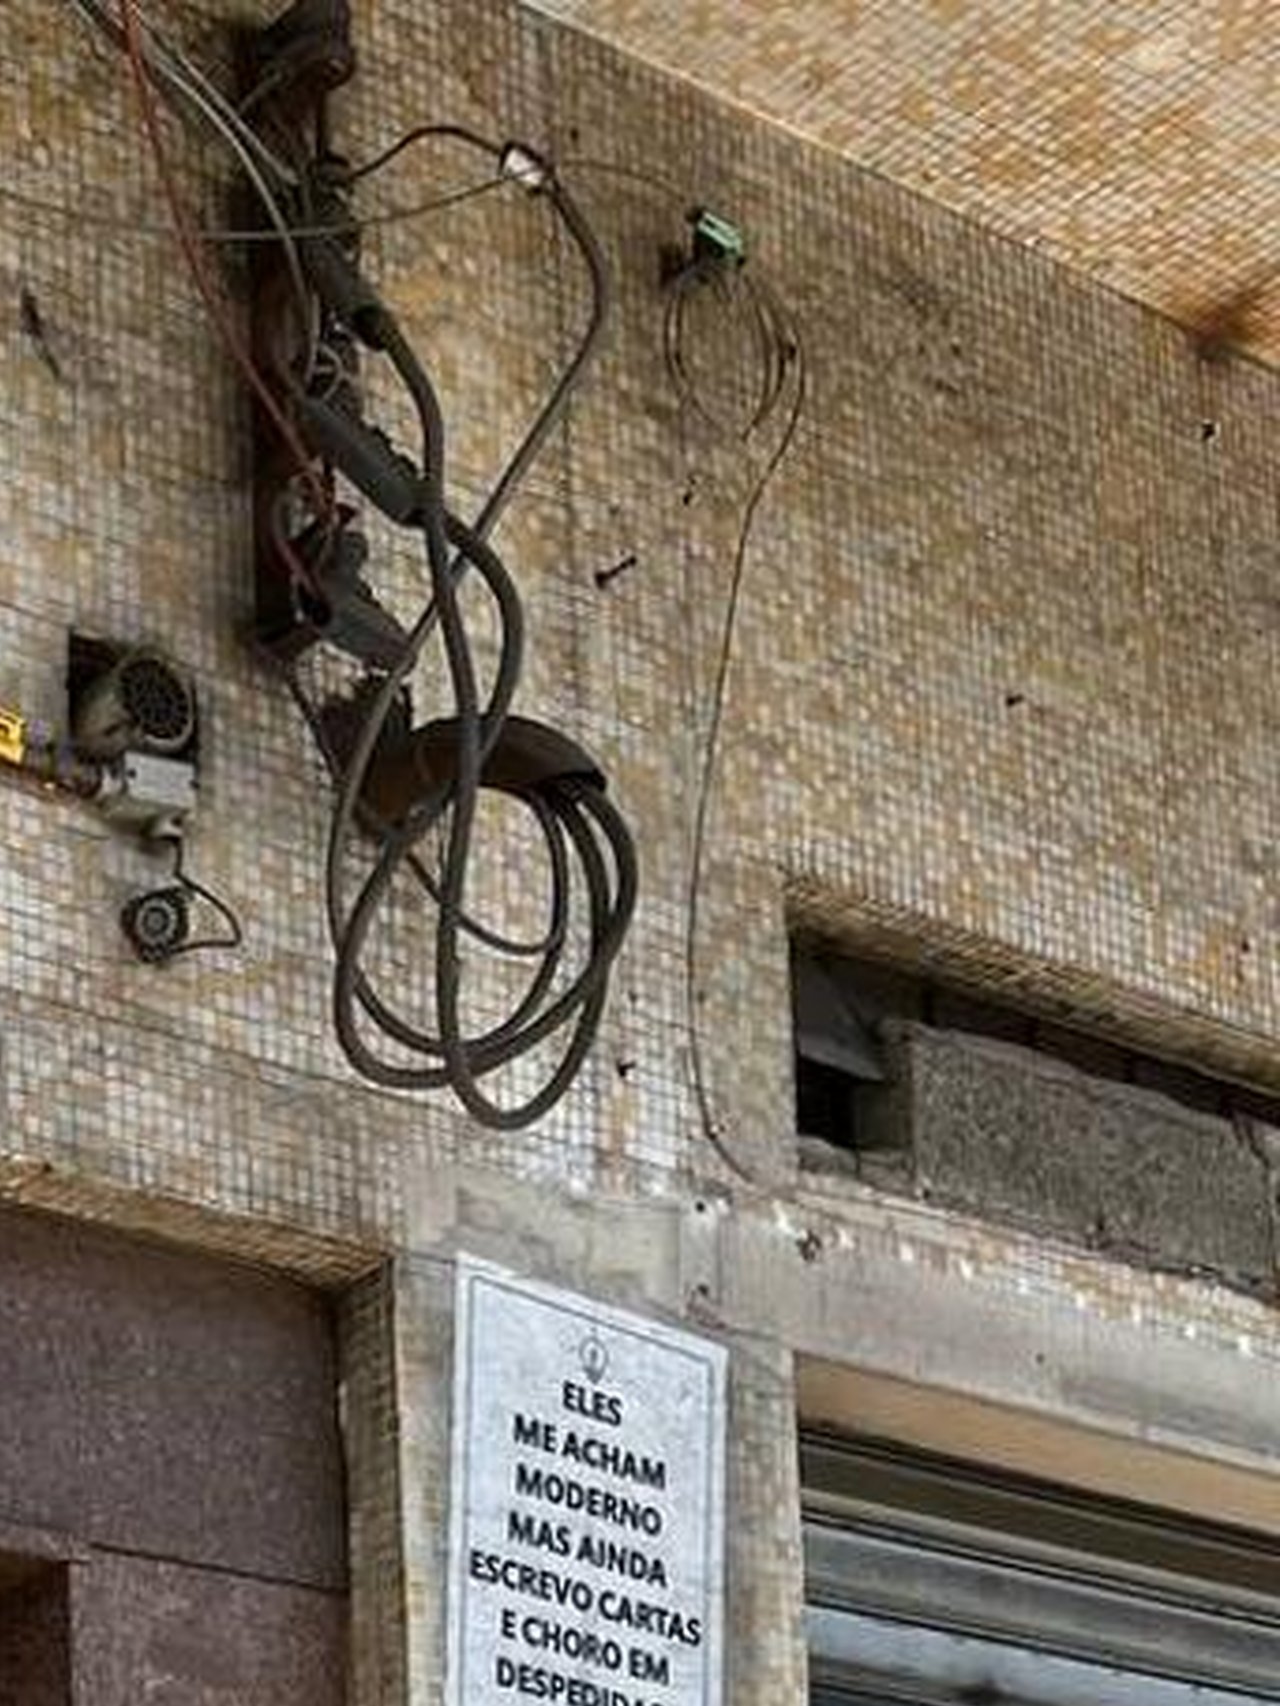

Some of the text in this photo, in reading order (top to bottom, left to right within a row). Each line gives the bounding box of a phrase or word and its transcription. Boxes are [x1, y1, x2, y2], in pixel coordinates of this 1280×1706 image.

[563, 1379, 622, 1427] ELES
[514, 1413, 666, 1491] ME ACHAM
[516, 1462, 662, 1537] MODERNO
[507, 1510, 667, 1588] MAS AINDA
[470, 1551, 702, 1647] ESCREVO CARTAS
[502, 1608, 670, 1687] E CHORO EM
